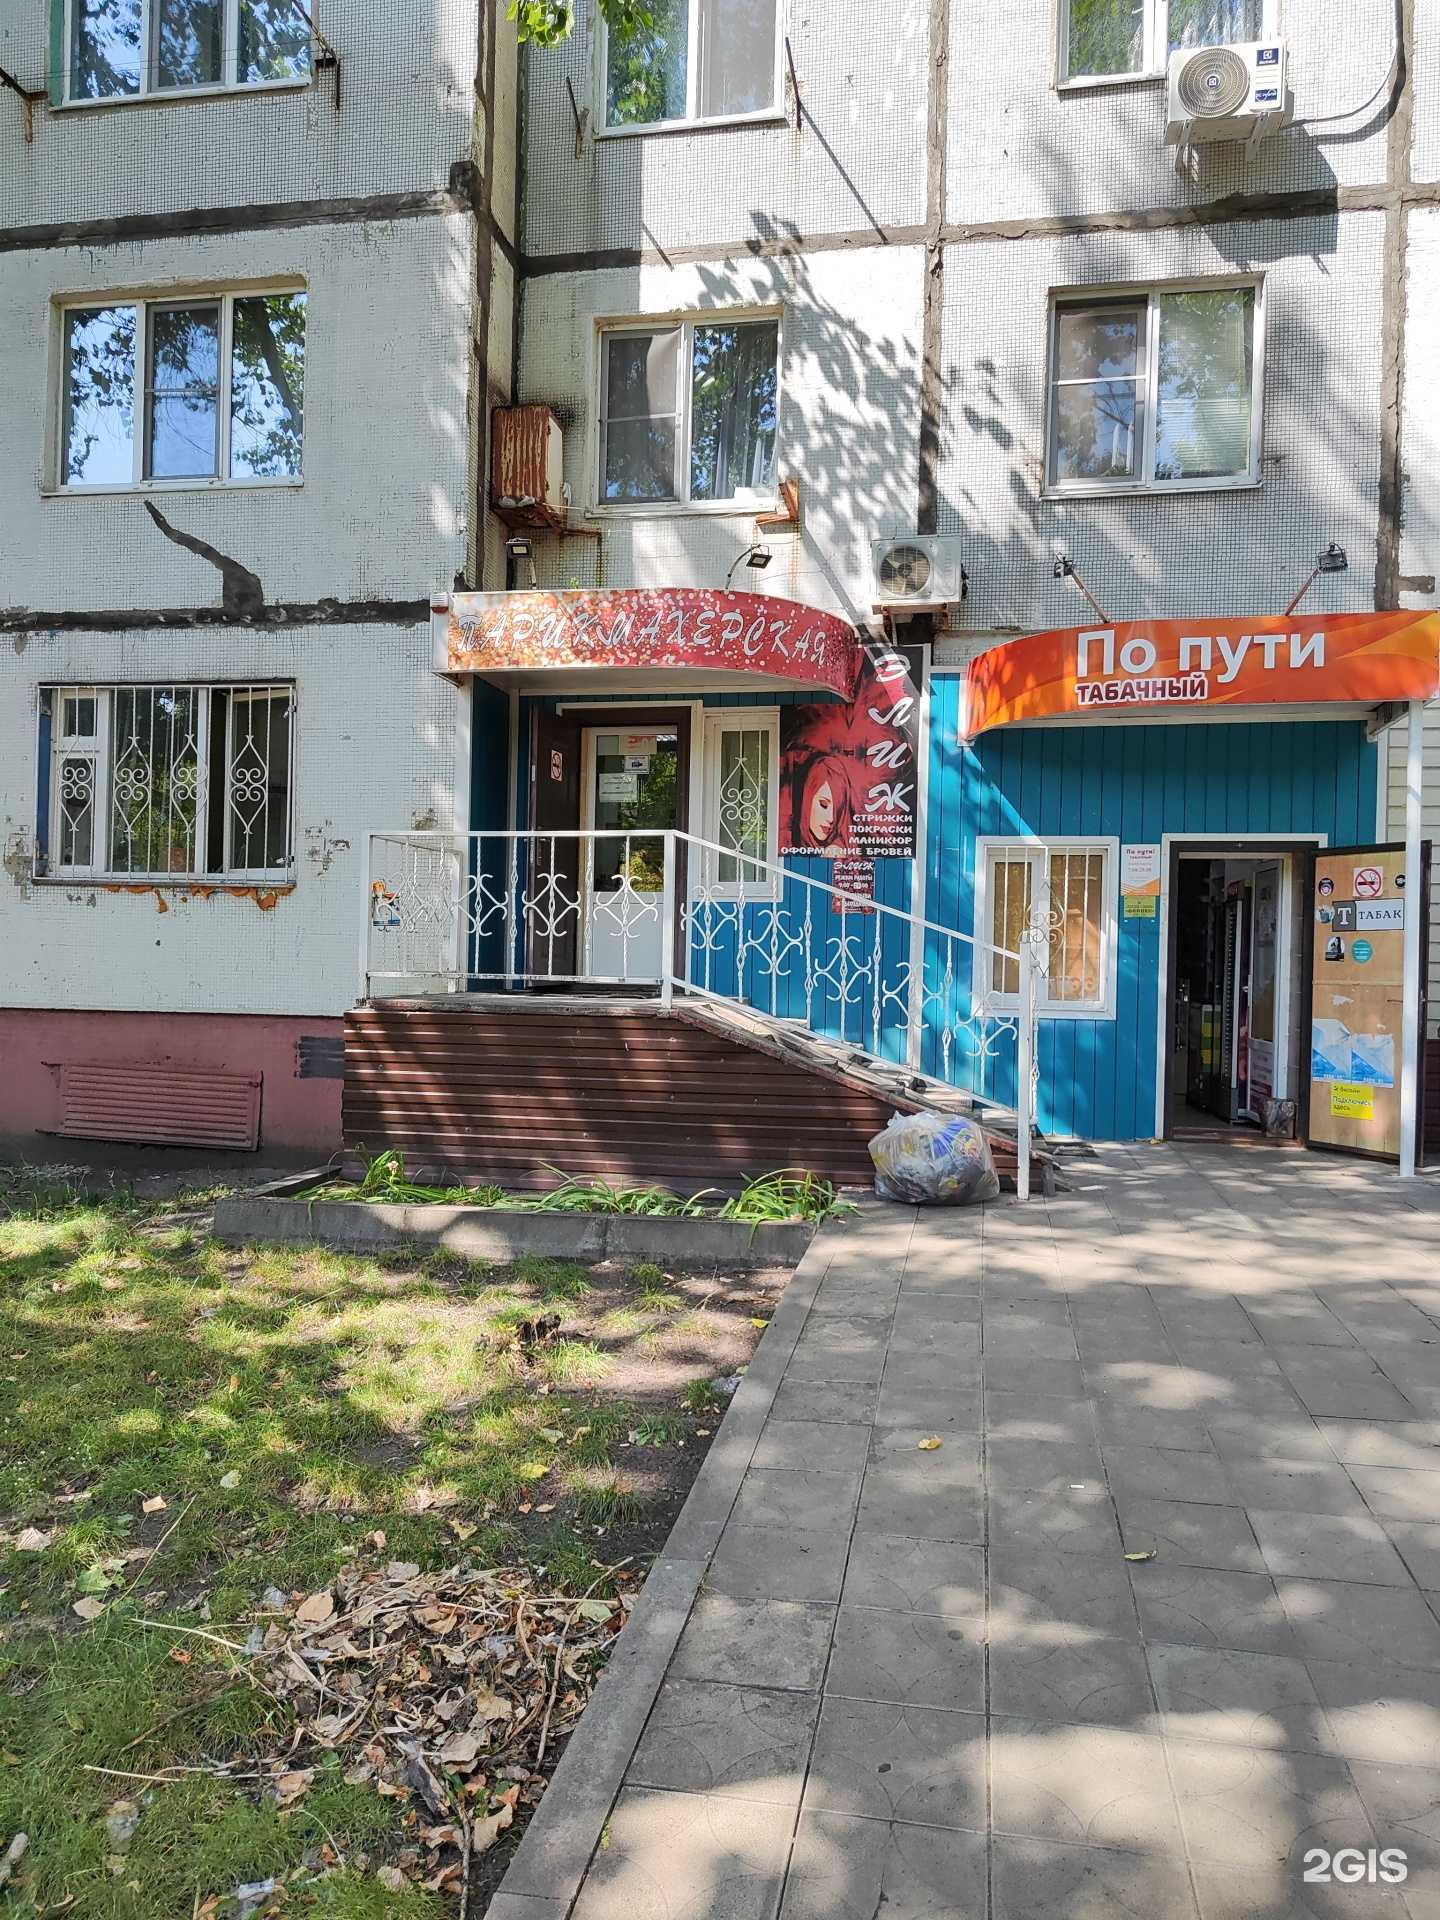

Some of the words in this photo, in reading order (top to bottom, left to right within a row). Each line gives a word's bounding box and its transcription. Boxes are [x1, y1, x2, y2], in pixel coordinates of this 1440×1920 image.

[457, 609, 827, 666] ПАРИКМАХЕРСКАЯ
[1077, 629, 1157, 678] По
[1179, 632, 1325, 683] пути
[1076, 672, 1208, 704] ТАБАЧНЫЙ
[852, 814, 913, 823] СТРИЖКИ
[848, 825, 913, 834] ПОКРАСКИ
[848, 836, 913, 845] МАНИКЮР
[865, 846, 913, 856] БРОВЕЙ
[1358, 909, 1402, 920] ТАБАК
